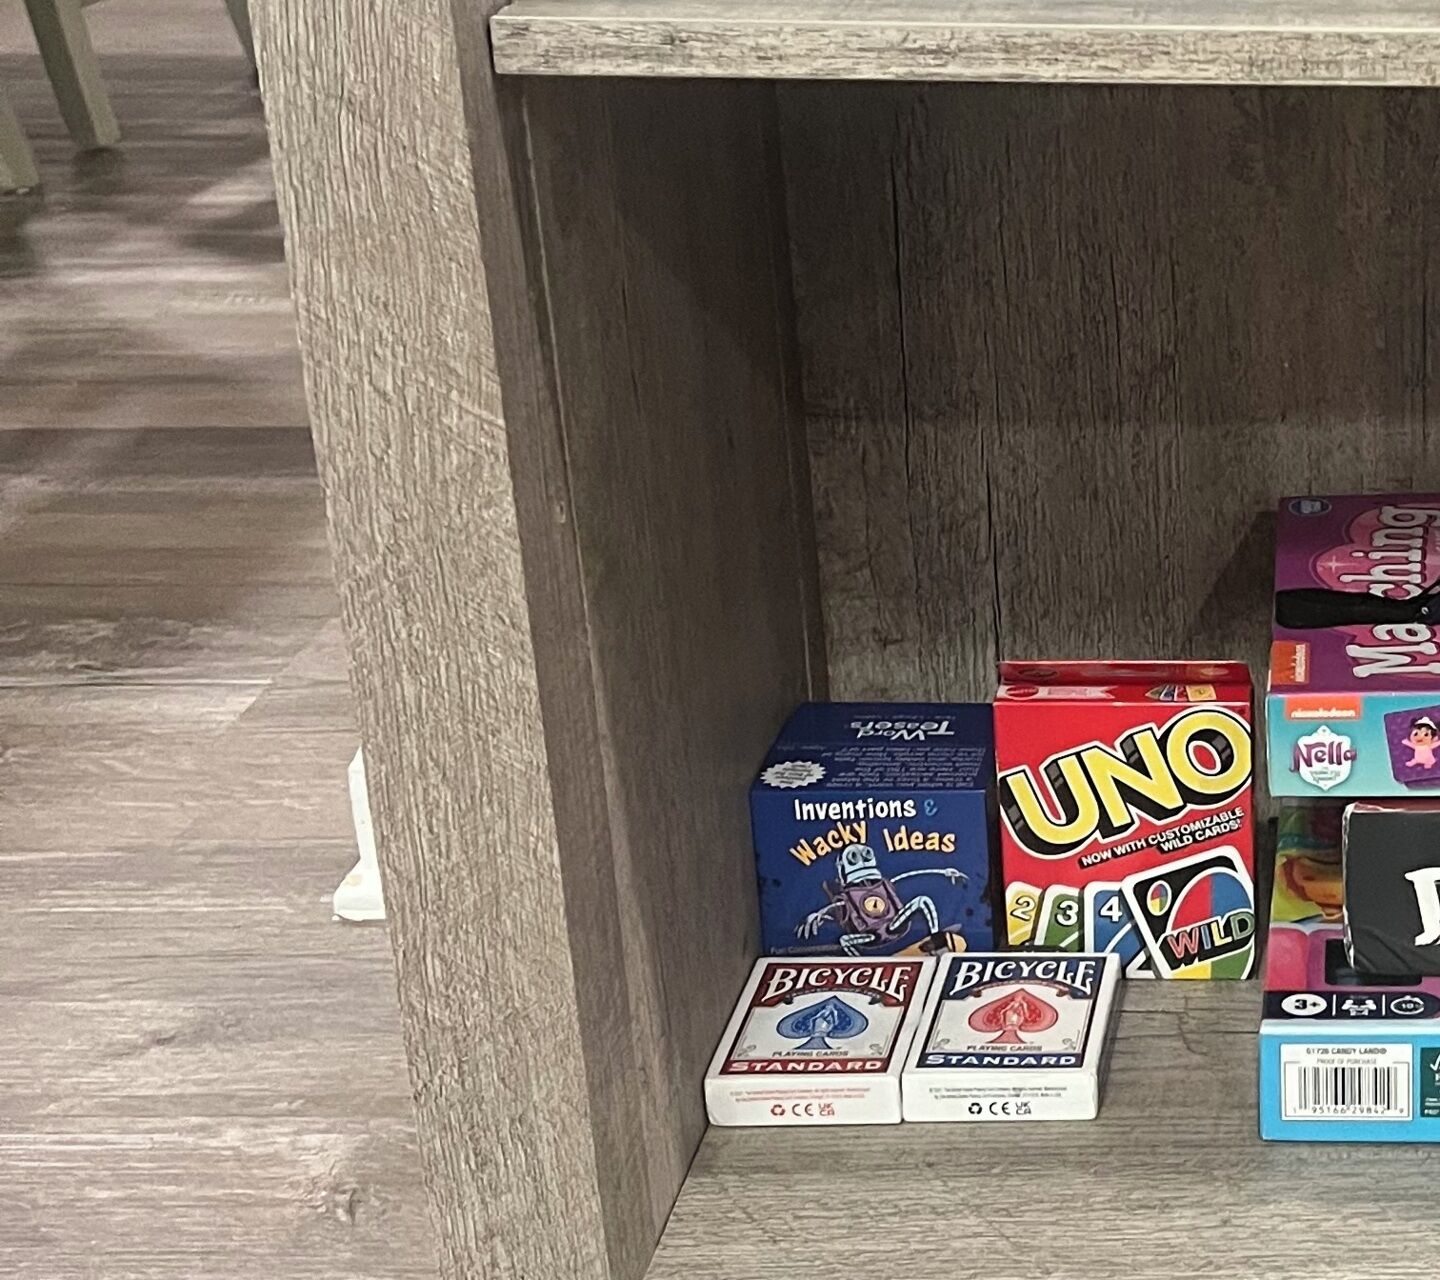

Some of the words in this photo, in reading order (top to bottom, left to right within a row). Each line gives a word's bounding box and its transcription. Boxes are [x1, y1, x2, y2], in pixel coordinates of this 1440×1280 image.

[850, 720, 956, 736] Teasers
[856, 725, 926, 741] Word
[1289, 740, 1358, 773] Nella
[1001, 708, 1251, 852] UNO
[794, 797, 917, 821] Inventions
[923, 799, 939, 817] &
[789, 820, 868, 866] Wacky
[883, 824, 956, 854] Ideas
[1081, 848, 1112, 867] NOW
[1113, 837, 1147, 859] WITH
[1148, 806, 1246, 847] CUSTOMIZABLE
[1160, 832, 1195, 854] WILD
[1195, 819, 1243, 844] CARDS!
[1010, 896, 1037, 922] 2
[1056, 899, 1079, 926] 3
[1100, 895, 1123, 922] 4
[1166, 910, 1255, 960] WILD
[760, 966, 912, 1003] BICYCLE
[949, 960, 1096, 996] BICYCLE
[1293, 998, 1322, 1011] 3+
[771, 1050, 814, 1058] PLAYING
[925, 1054, 1077, 1066] STANDARD
[1009, 1044, 1043, 1052] CARDS
[728, 1060, 883, 1072] STANDARD
[1311, 1106, 1347, 1114] 95166
[1351, 1106, 1385, 1114] 29842
